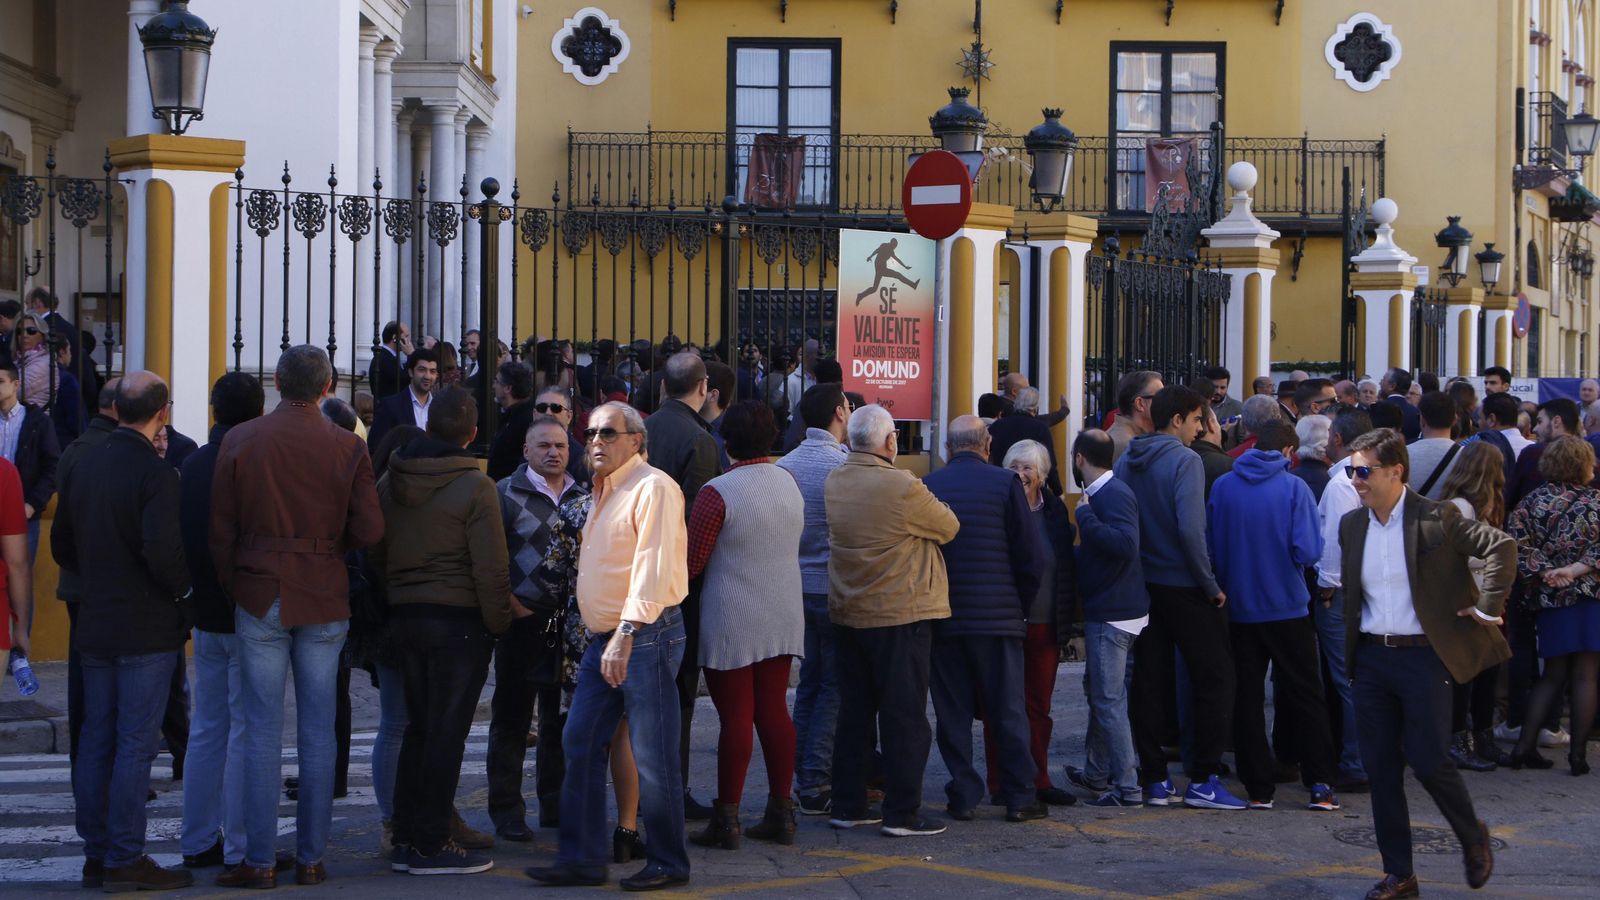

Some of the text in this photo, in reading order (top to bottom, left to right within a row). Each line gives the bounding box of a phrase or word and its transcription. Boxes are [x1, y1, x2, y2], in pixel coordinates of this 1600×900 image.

[879, 283, 897, 314] SÉ
[853, 315, 920, 345] VALIENTE
[853, 345, 862, 357] LA
[887, 346, 895, 358] TE
[896, 346, 920, 359] ESPERA
[853, 359, 920, 379] DOMUND
